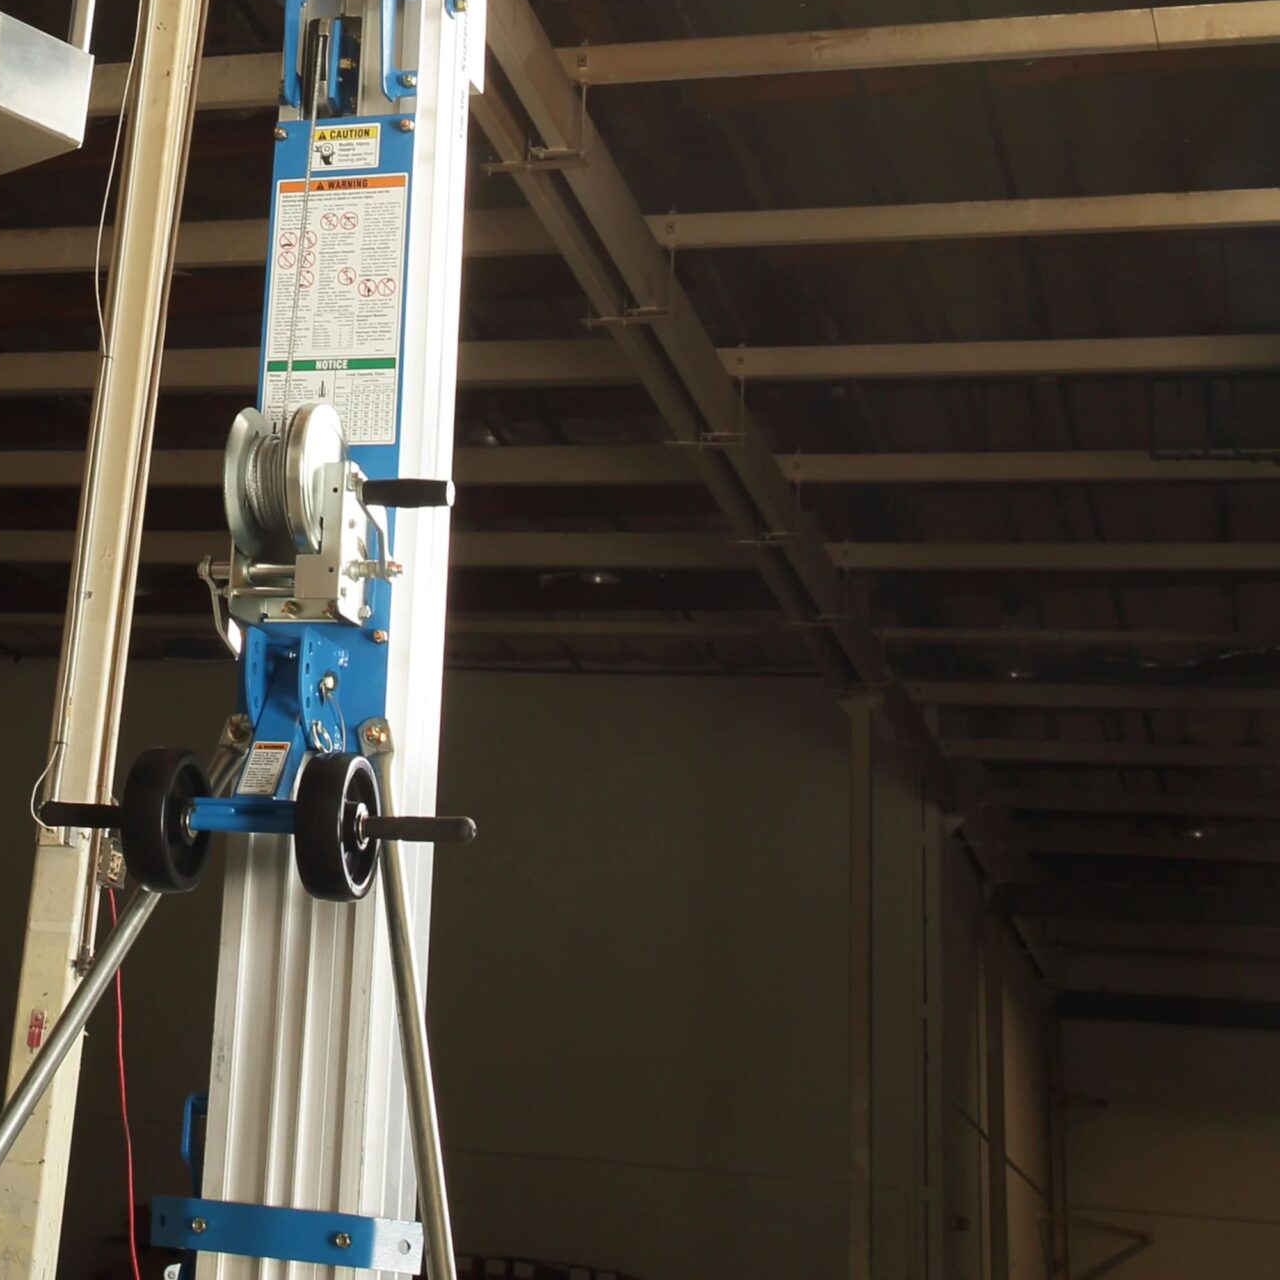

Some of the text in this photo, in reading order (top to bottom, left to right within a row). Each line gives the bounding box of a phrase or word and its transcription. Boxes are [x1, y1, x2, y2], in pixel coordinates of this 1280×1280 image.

[329, 128, 370, 140] CAUTION
[327, 178, 368, 190] WARNING
[315, 359, 349, 370] NOTICE
